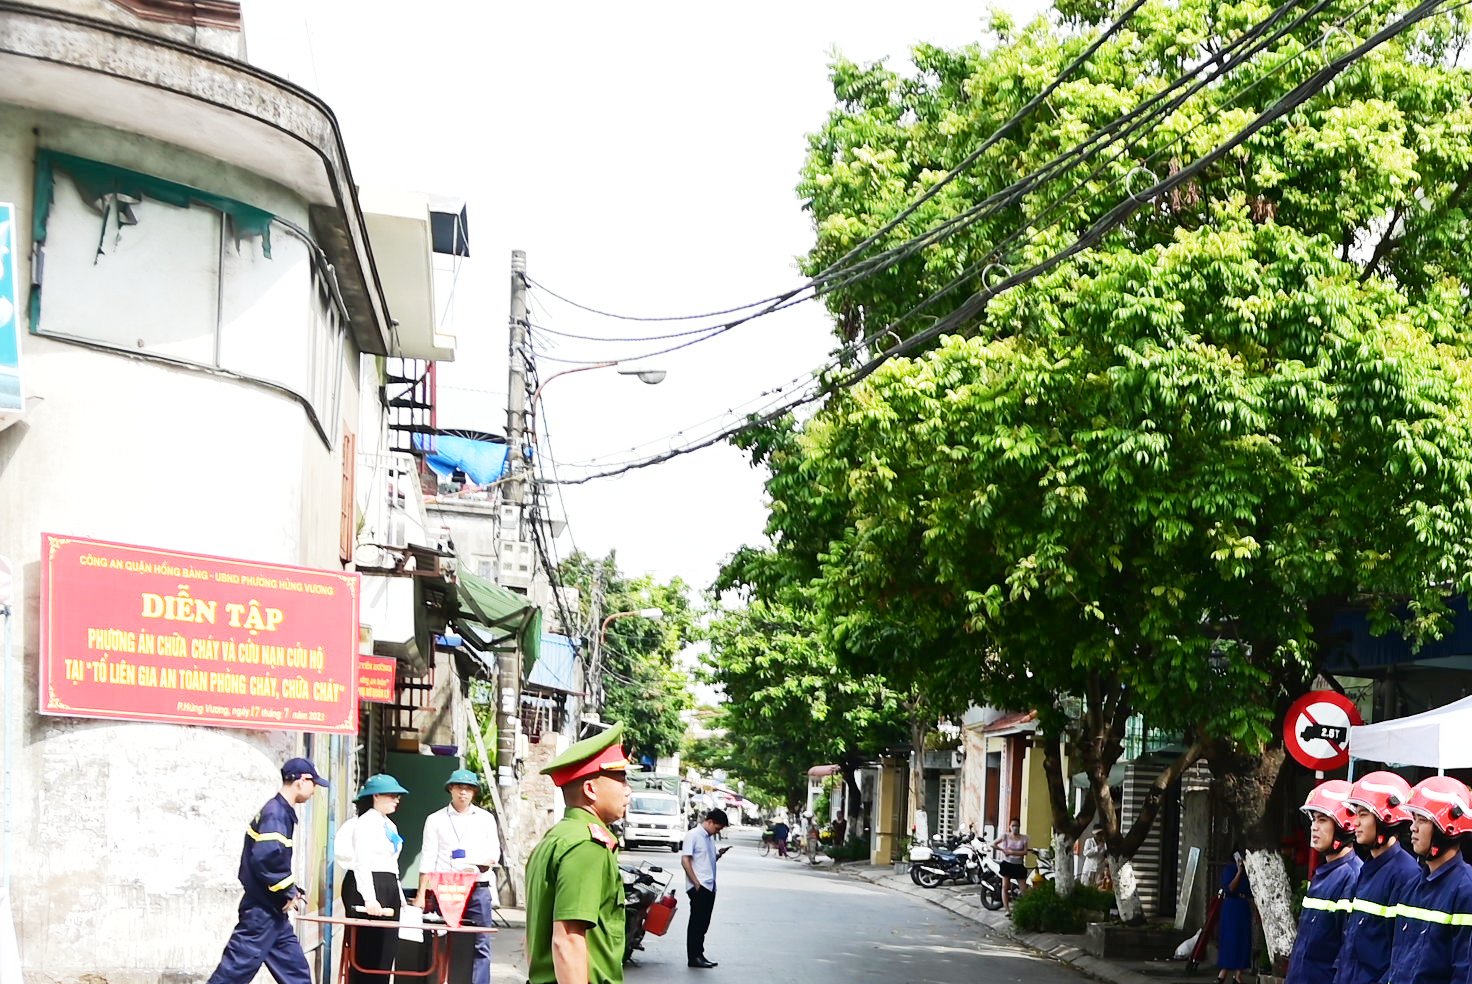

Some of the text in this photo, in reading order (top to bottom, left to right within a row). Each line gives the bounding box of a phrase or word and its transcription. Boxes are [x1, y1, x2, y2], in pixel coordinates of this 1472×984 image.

[80, 553, 108, 567] CÔNG
[109, 559, 123, 569] AN
[125, 560, 152, 574] QUẬN
[154, 560, 181, 576] HỒNG
[182, 565, 209, 580] BÀNG
[215, 571, 240, 584] UBND
[279, 577, 303, 592] HÙNG
[141, 584, 283, 635] DIỄN TẬP
[138, 628, 154, 654] ÁN
[157, 631, 187, 657] CHỮA
[191, 635, 220, 660] CHÁY
[222, 637, 236, 662] VÀ
[261, 644, 284, 669] NẠN
[310, 646, 324, 674] HỘ
[64, 658, 84, 685] TẠI
[110, 659, 135, 685] LIÊN
[138, 665, 158, 687] GIA
[159, 667, 177, 689] AN
[179, 665, 208, 691] TOÀN
[210, 667, 246, 694] PHÒNG
[250, 672, 279, 699] CHÁY,
[282, 675, 309, 700] CHỮA
[284, 707, 289, 718] 7
